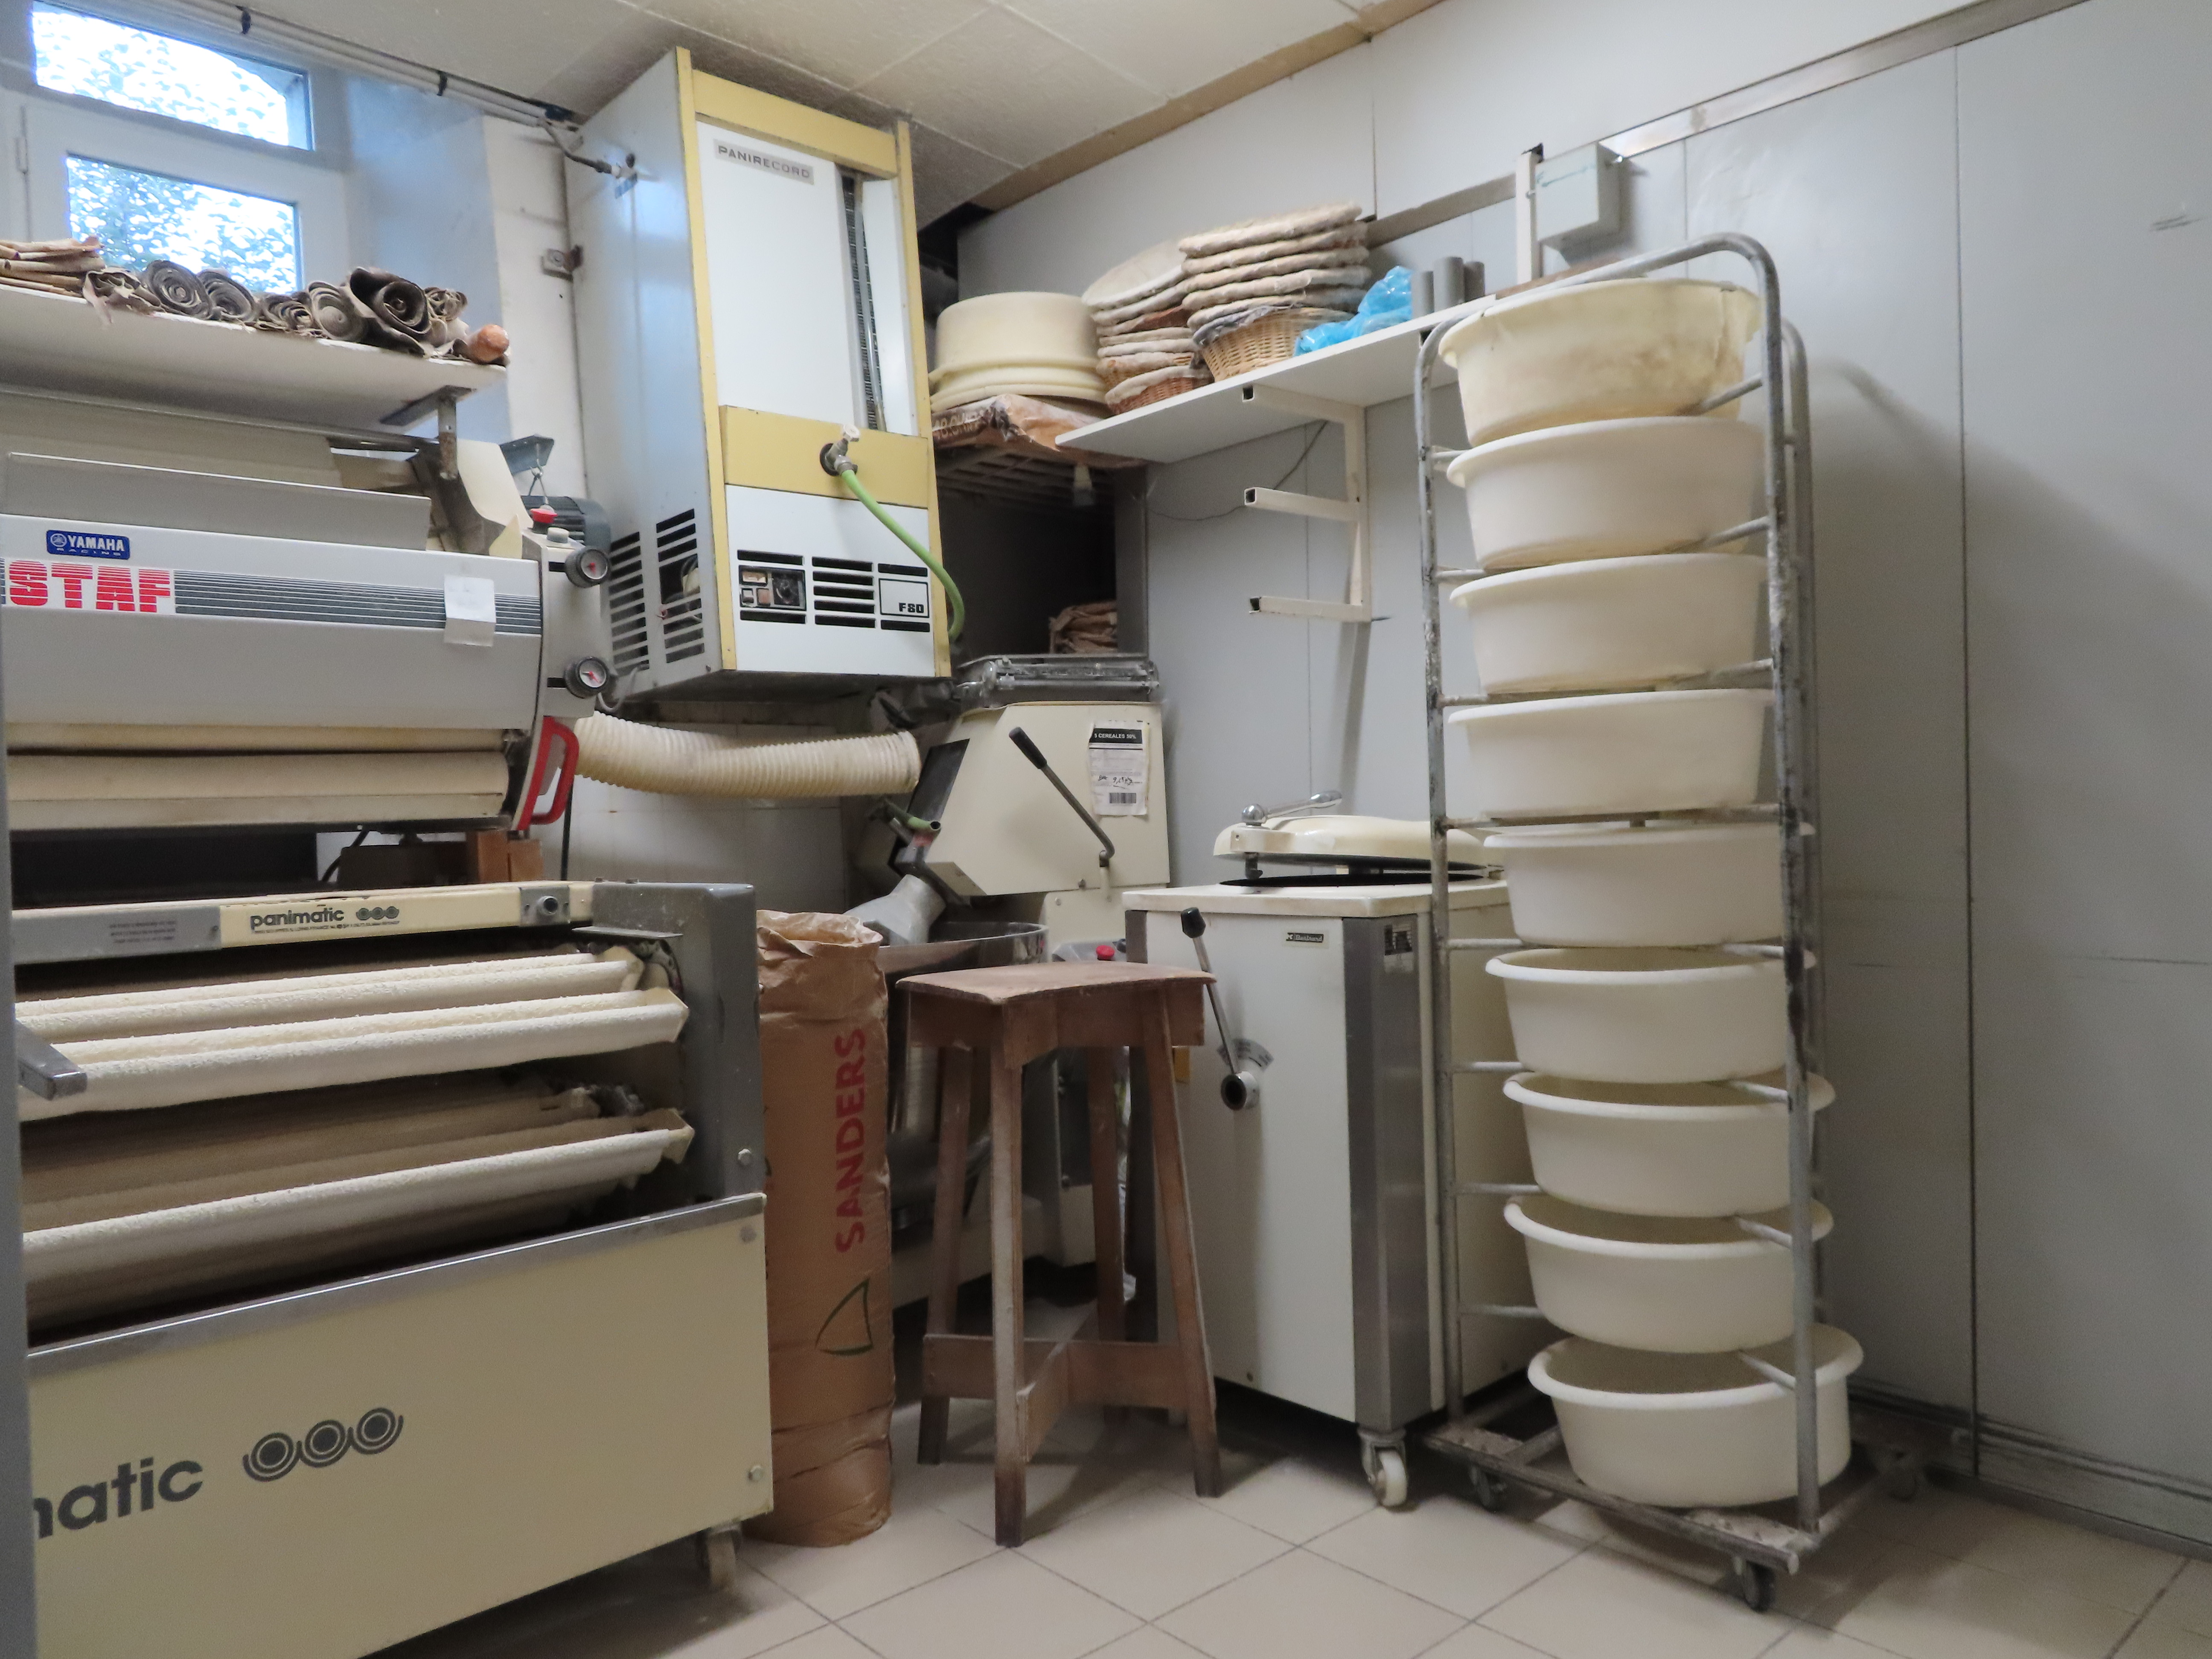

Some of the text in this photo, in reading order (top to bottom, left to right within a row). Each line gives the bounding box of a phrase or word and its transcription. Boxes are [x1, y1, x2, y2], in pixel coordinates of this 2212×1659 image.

[718, 145, 810, 178] PANIRECORD
[67, 534, 125, 552] YAMAHA
[9, 560, 171, 613] STAF
[899, 602, 924, 613] F80
[250, 907, 345, 932] panimatic
[835, 1028, 866, 1254] SANDERS
